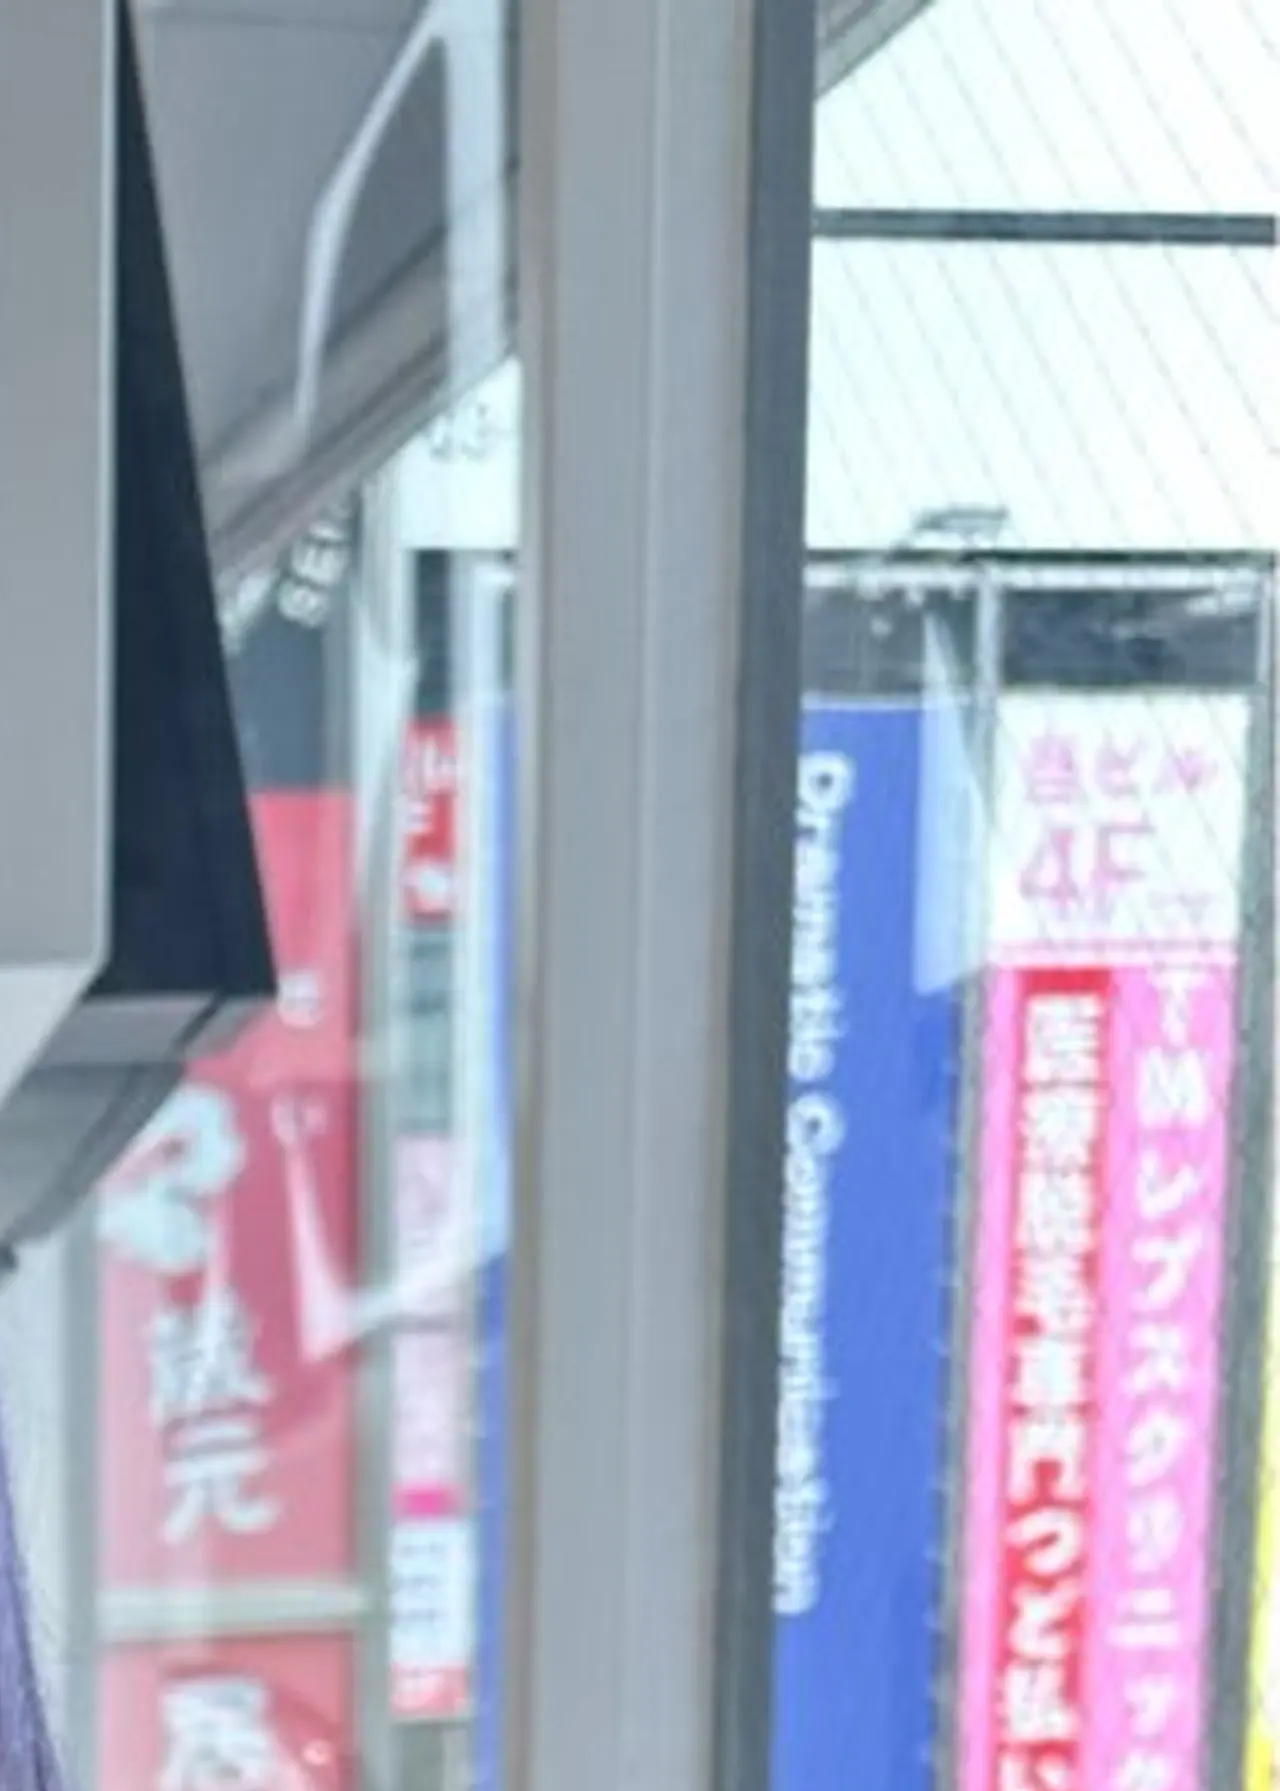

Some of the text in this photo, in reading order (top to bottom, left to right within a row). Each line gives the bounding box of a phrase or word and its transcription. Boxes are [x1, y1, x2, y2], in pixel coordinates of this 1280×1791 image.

[1020, 822, 1154, 920] 4F
[773, 752, 854, 1614] Dramatic Communication
